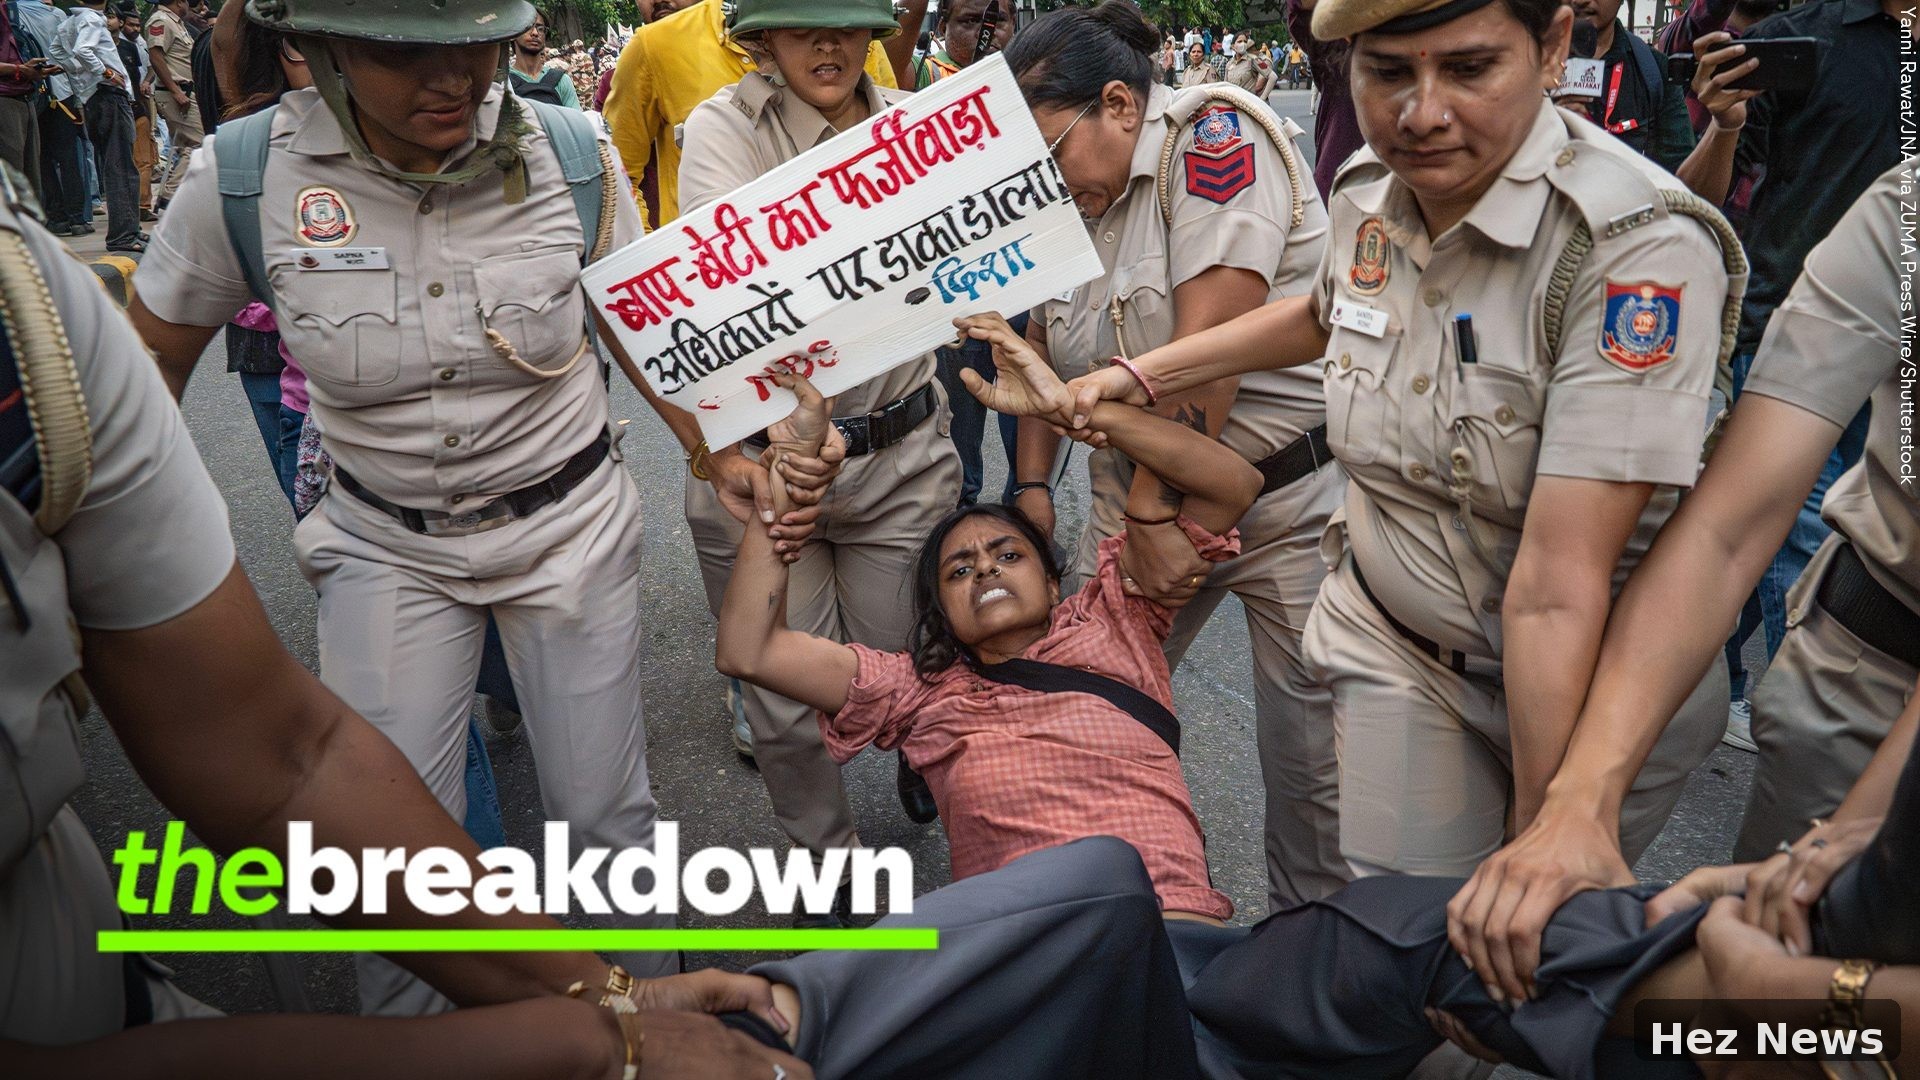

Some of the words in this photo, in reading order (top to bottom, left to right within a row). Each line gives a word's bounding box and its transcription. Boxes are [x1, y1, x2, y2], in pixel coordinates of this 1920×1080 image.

[605, 203, 768, 331] बाप-बेटी
[759, 181, 832, 251] का
[806, 246, 885, 301] पर
[874, 204, 970, 282] डाका
